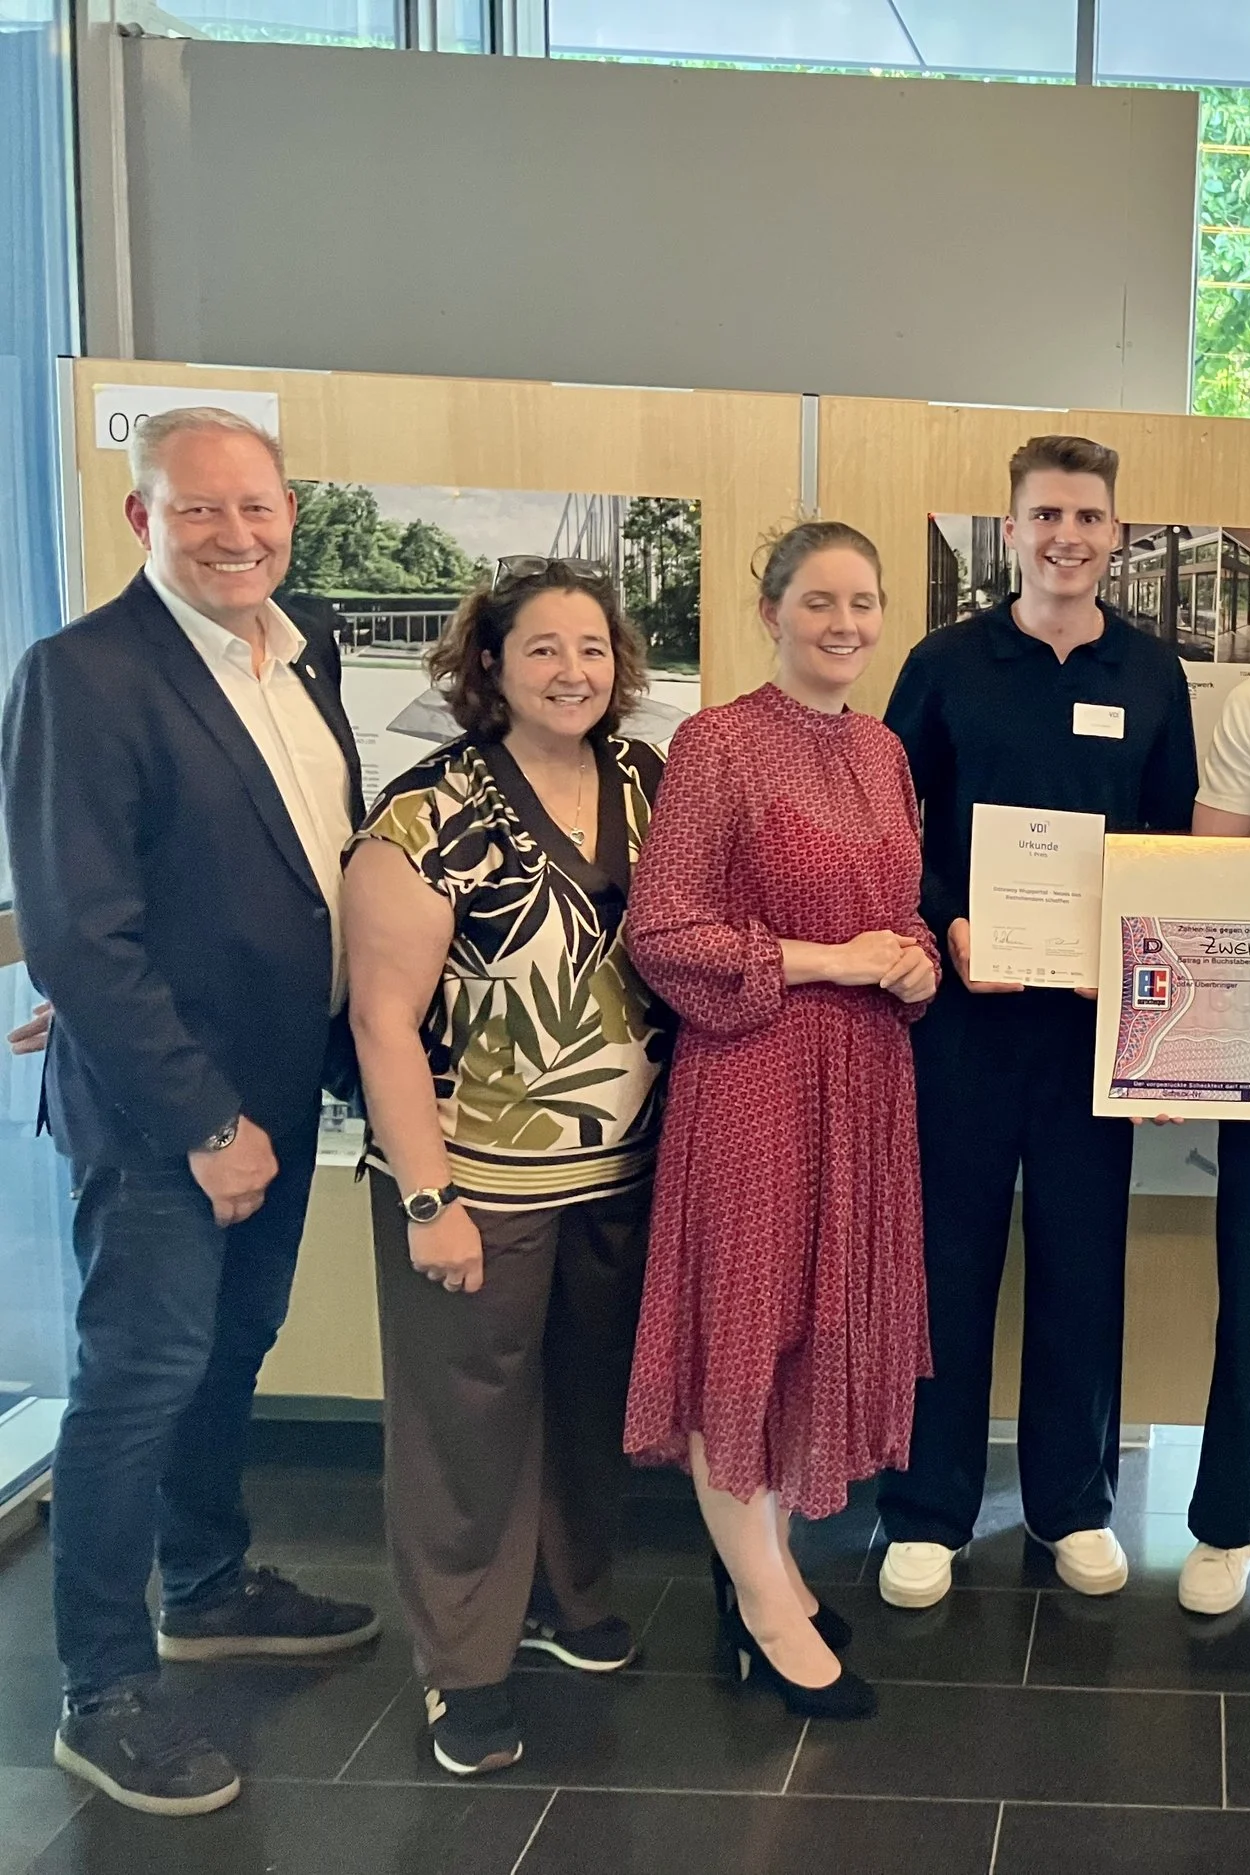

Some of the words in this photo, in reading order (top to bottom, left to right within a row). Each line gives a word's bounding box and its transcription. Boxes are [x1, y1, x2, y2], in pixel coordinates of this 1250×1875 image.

[109, 412, 150, 442] 0
[1030, 822, 1047, 833] VDI
[1018, 840, 1059, 851] Urkunde
[1143, 938, 1163, 953] D
[1178, 956, 1201, 964] Betrag
